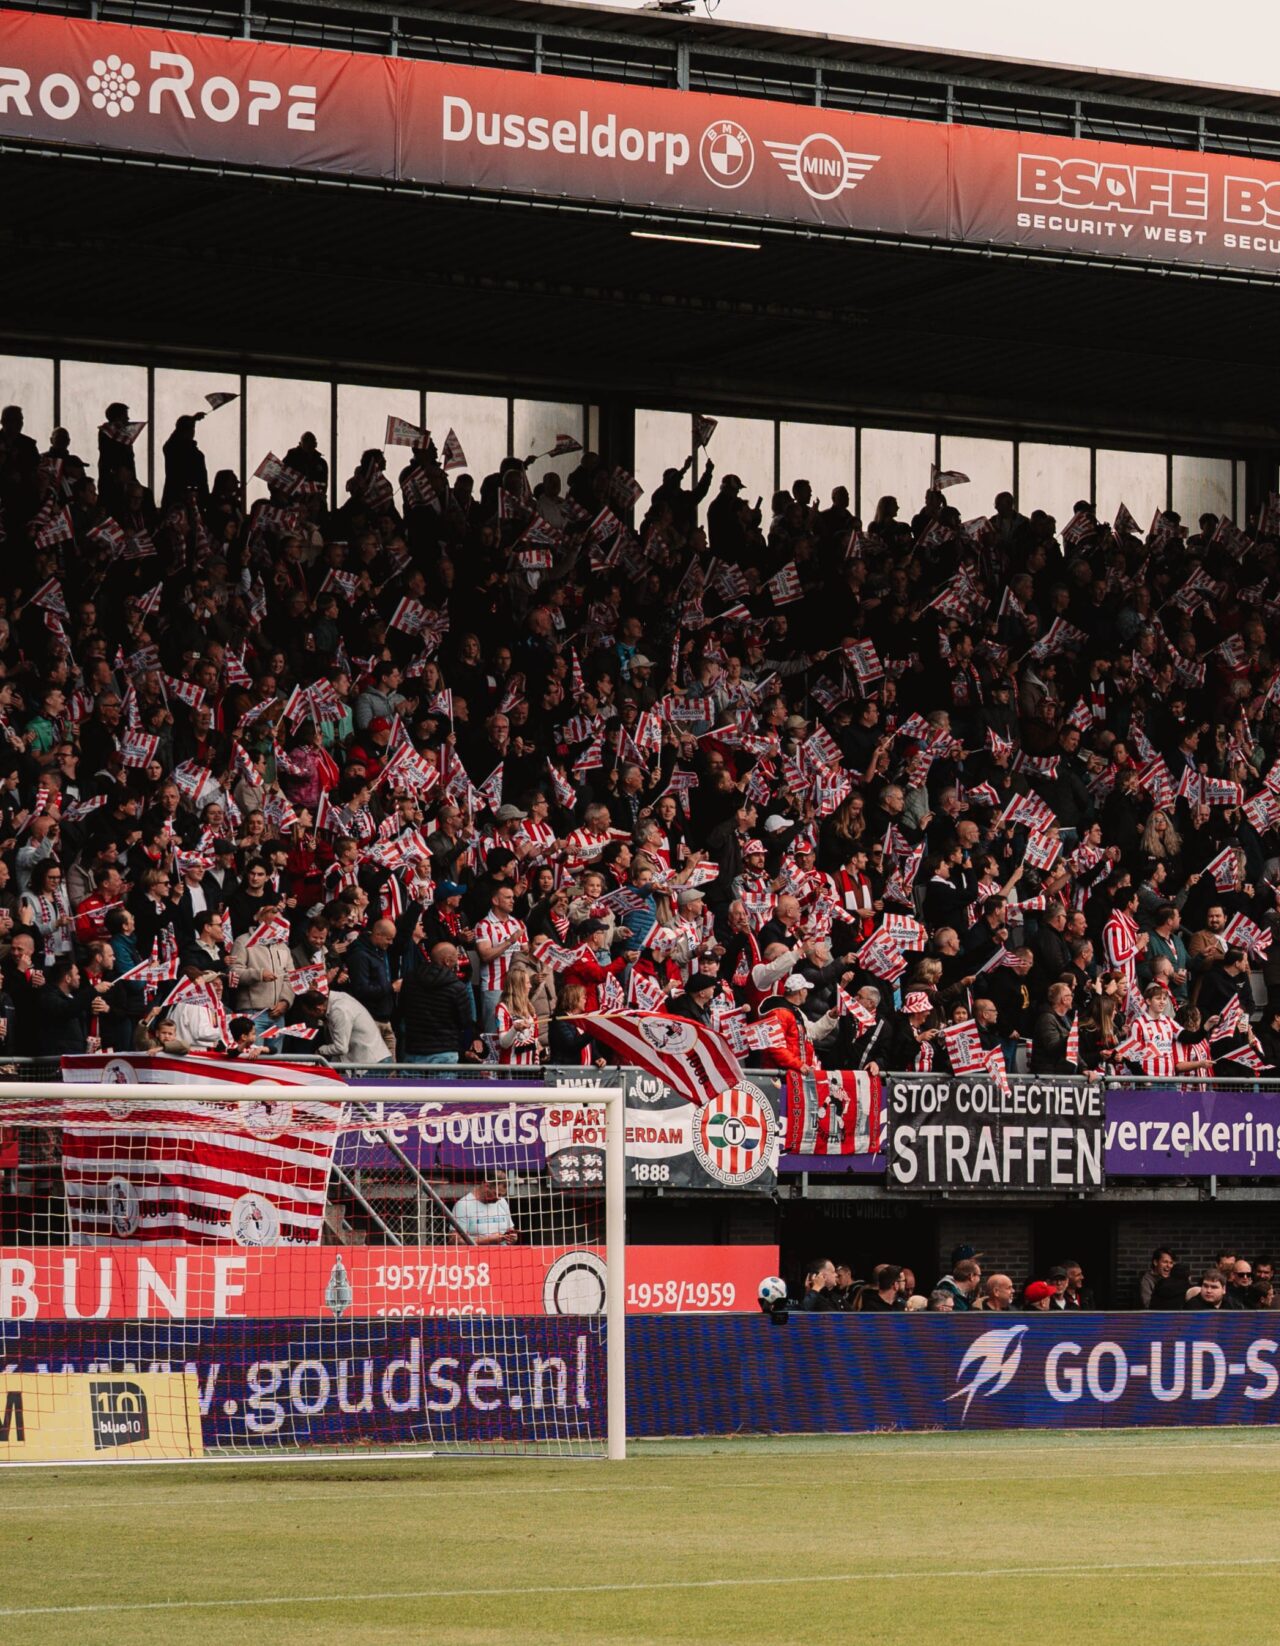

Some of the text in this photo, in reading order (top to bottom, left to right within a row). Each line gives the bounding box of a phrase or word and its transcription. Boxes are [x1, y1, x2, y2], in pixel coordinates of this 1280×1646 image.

[149, 51, 317, 132] ROPE
[442, 95, 689, 175] Dusseldorp
[707, 123, 748, 145] BMW
[803, 156, 841, 177] MINI
[1017, 153, 1208, 219] BSAFE
[1016, 212, 1208, 246] SECURITY WEST
[644, 1080, 656, 1093] M
[892, 1083, 950, 1115] STOP
[955, 1082, 1100, 1116] COLLECTIEVE
[550, 1110, 607, 1127] SPART
[729, 1123, 741, 1140] T
[572, 1127, 683, 1144] ROTERDAM
[892, 1124, 1101, 1185] STRAFFEN
[631, 1164, 670, 1182] 1888
[375, 1262, 490, 1295] 1957/1958
[627, 1281, 735, 1311] 1958/1959
[37, 1335, 591, 1434] .goudse.nl
[100, 1419, 141, 1434] blue10
